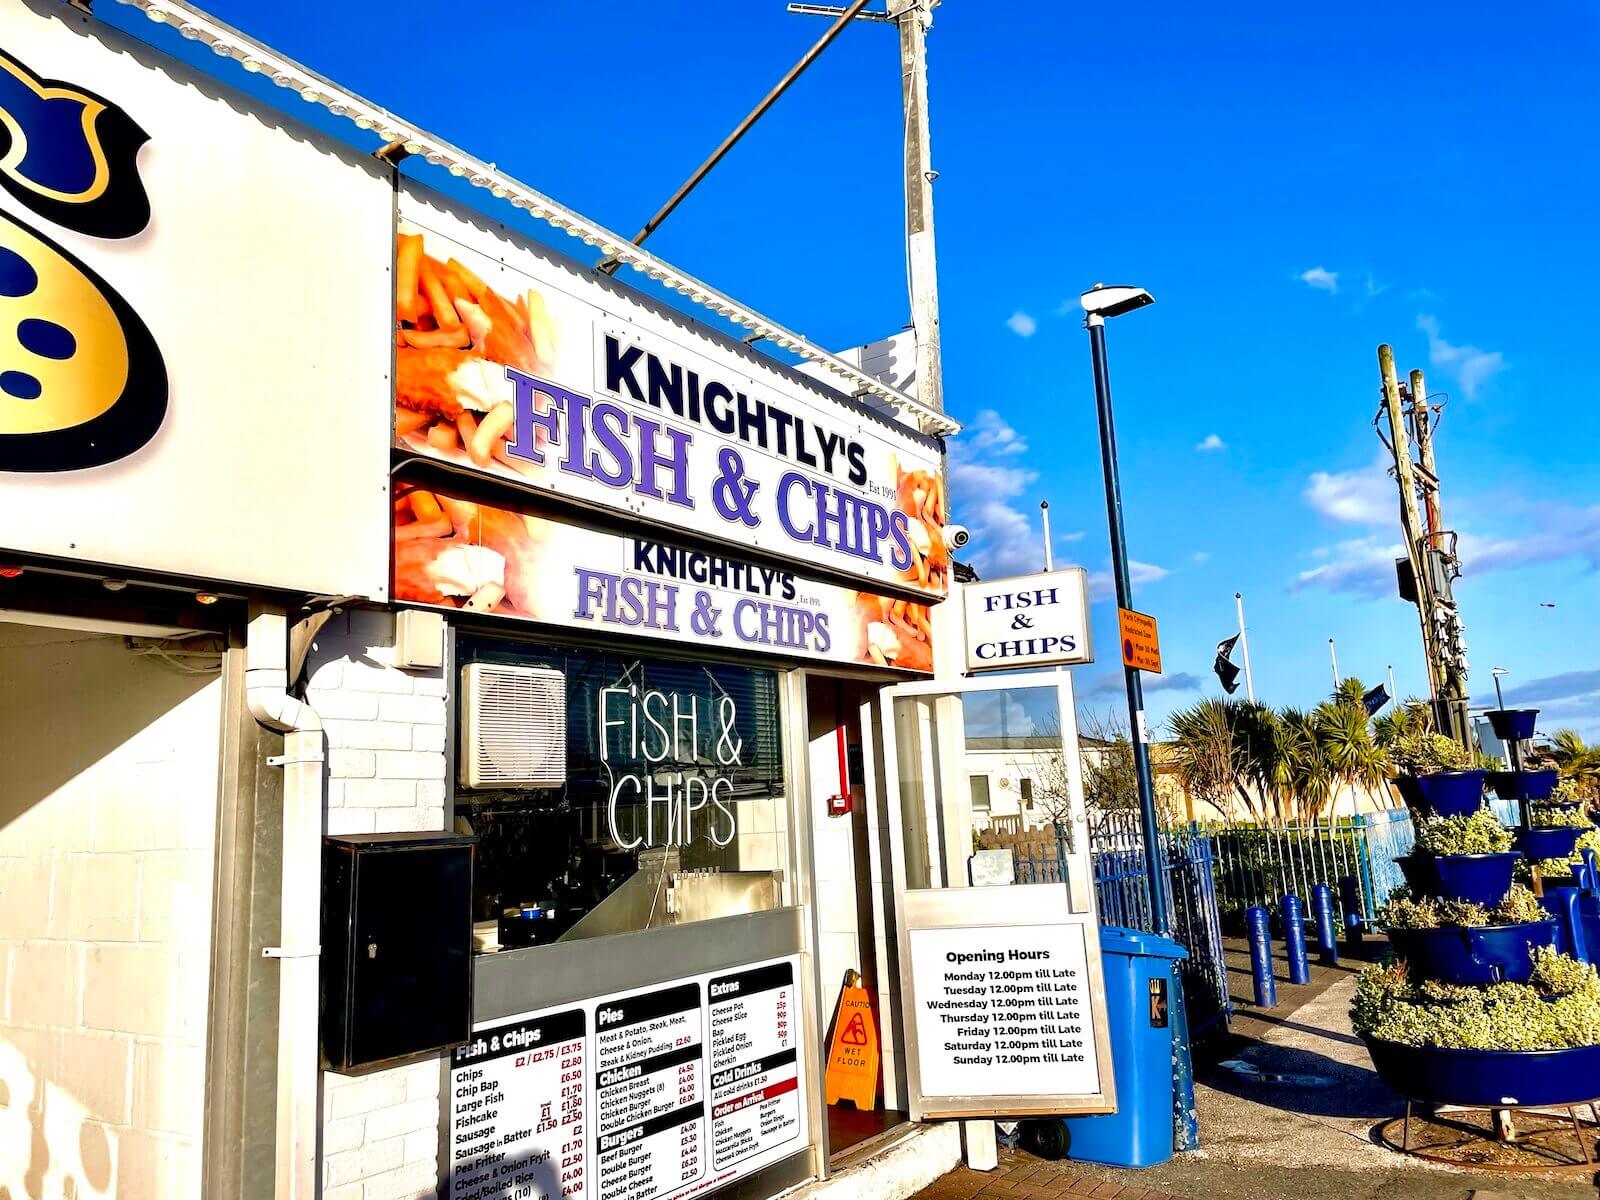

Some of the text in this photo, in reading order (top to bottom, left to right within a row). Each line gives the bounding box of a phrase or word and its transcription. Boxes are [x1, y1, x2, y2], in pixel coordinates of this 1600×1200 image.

[605, 334, 868, 486] KNIGHTLY'S
[505, 364, 912, 571] FISH & CHIPS
[869, 480, 881, 495] Est
[634, 539, 796, 601] KNIGHTLY'S
[574, 566, 831, 651] FISH & CHIPS
[983, 588, 1060, 612] FISH
[1011, 613, 1034, 630] &
[975, 635, 1076, 659] CHIPS
[717, 697, 742, 765] &
[946, 949, 1050, 965] Opening Hours
[944, 969, 1076, 982] Monday 12.00pm till Late
[711, 981, 739, 997] Extras
[944, 983, 1077, 995] Tuesday 12.00pm till Late
[927, 997, 1078, 1009] Wednesday 12.00pm till Late
[599, 1008, 624, 1025] Pies
[940, 1011, 1080, 1023] Thursday 12.00pm till Late
[600, 1033, 617, 1044] Meat
[957, 1025, 1081, 1037] Friday 12.00pm till Late
[456, 1027, 541, 1061] Fish & Chips
[600, 1043, 624, 1056] Cheese
[844, 1047, 862, 1056] WET
[944, 1039, 1083, 1051] Saturday 12.00pm till Late
[456, 1069, 483, 1083] Chips
[515, 1056, 525, 1068] £2
[532, 1049, 554, 1063] £2.75
[561, 1042, 582, 1056] £3.75
[837, 1058, 866, 1067] FLOOR
[953, 1054, 1084, 1065] Sunday 12.00pm till Late
[600, 1065, 641, 1086] Chicken
[713, 1064, 761, 1087] Cold Drinks
[456, 1084, 478, 1098] Chip
[480, 1079, 498, 1092] Bap
[456, 1070, 582, 1114] Large Fish £6.50
[601, 1086, 627, 1099] Chicken
[629, 1078, 650, 1089] Breast
[601, 1096, 627, 1109] Chicken
[629, 1087, 655, 1100] Nuggets
[456, 1083, 582, 1129] Fishcake £1.70
[601, 1107, 627, 1120] Chicken
[630, 1099, 651, 1111] Burger
[714, 1104, 733, 1116] Order
[455, 1125, 496, 1144] Sausage
[542, 1106, 550, 1118] £1
[601, 1118, 624, 1132] Double
[627, 1109, 652, 1123] Chicken
[455, 1141, 496, 1160] Sausage
[496, 1139, 503, 1147] in
[503, 1128, 533, 1145] Batter
[601, 1126, 643, 1150] Burgers
[455, 1125, 583, 1176] Pea Fritter £2
[601, 1152, 618, 1164] Beef
[619, 1144, 642, 1157] Burger
[455, 1173, 489, 1192] Cheese
[492, 1168, 498, 1179] &
[500, 1160, 528, 1175] Onion
[561, 1139, 583, 1154] £1.70
[515, 1171, 534, 1186] Rice
[561, 1153, 583, 1168] £2.50
[561, 1167, 583, 1182] £4.00
[602, 1162, 626, 1176] Double
[629, 1152, 651, 1166] Burger
[601, 1174, 627, 1189] Cheese
[629, 1164, 651, 1178] Burger
[629, 1176, 653, 1190] Cheese
[561, 1181, 583, 1197] £4.00
[636, 1186, 657, 1198] Batter
